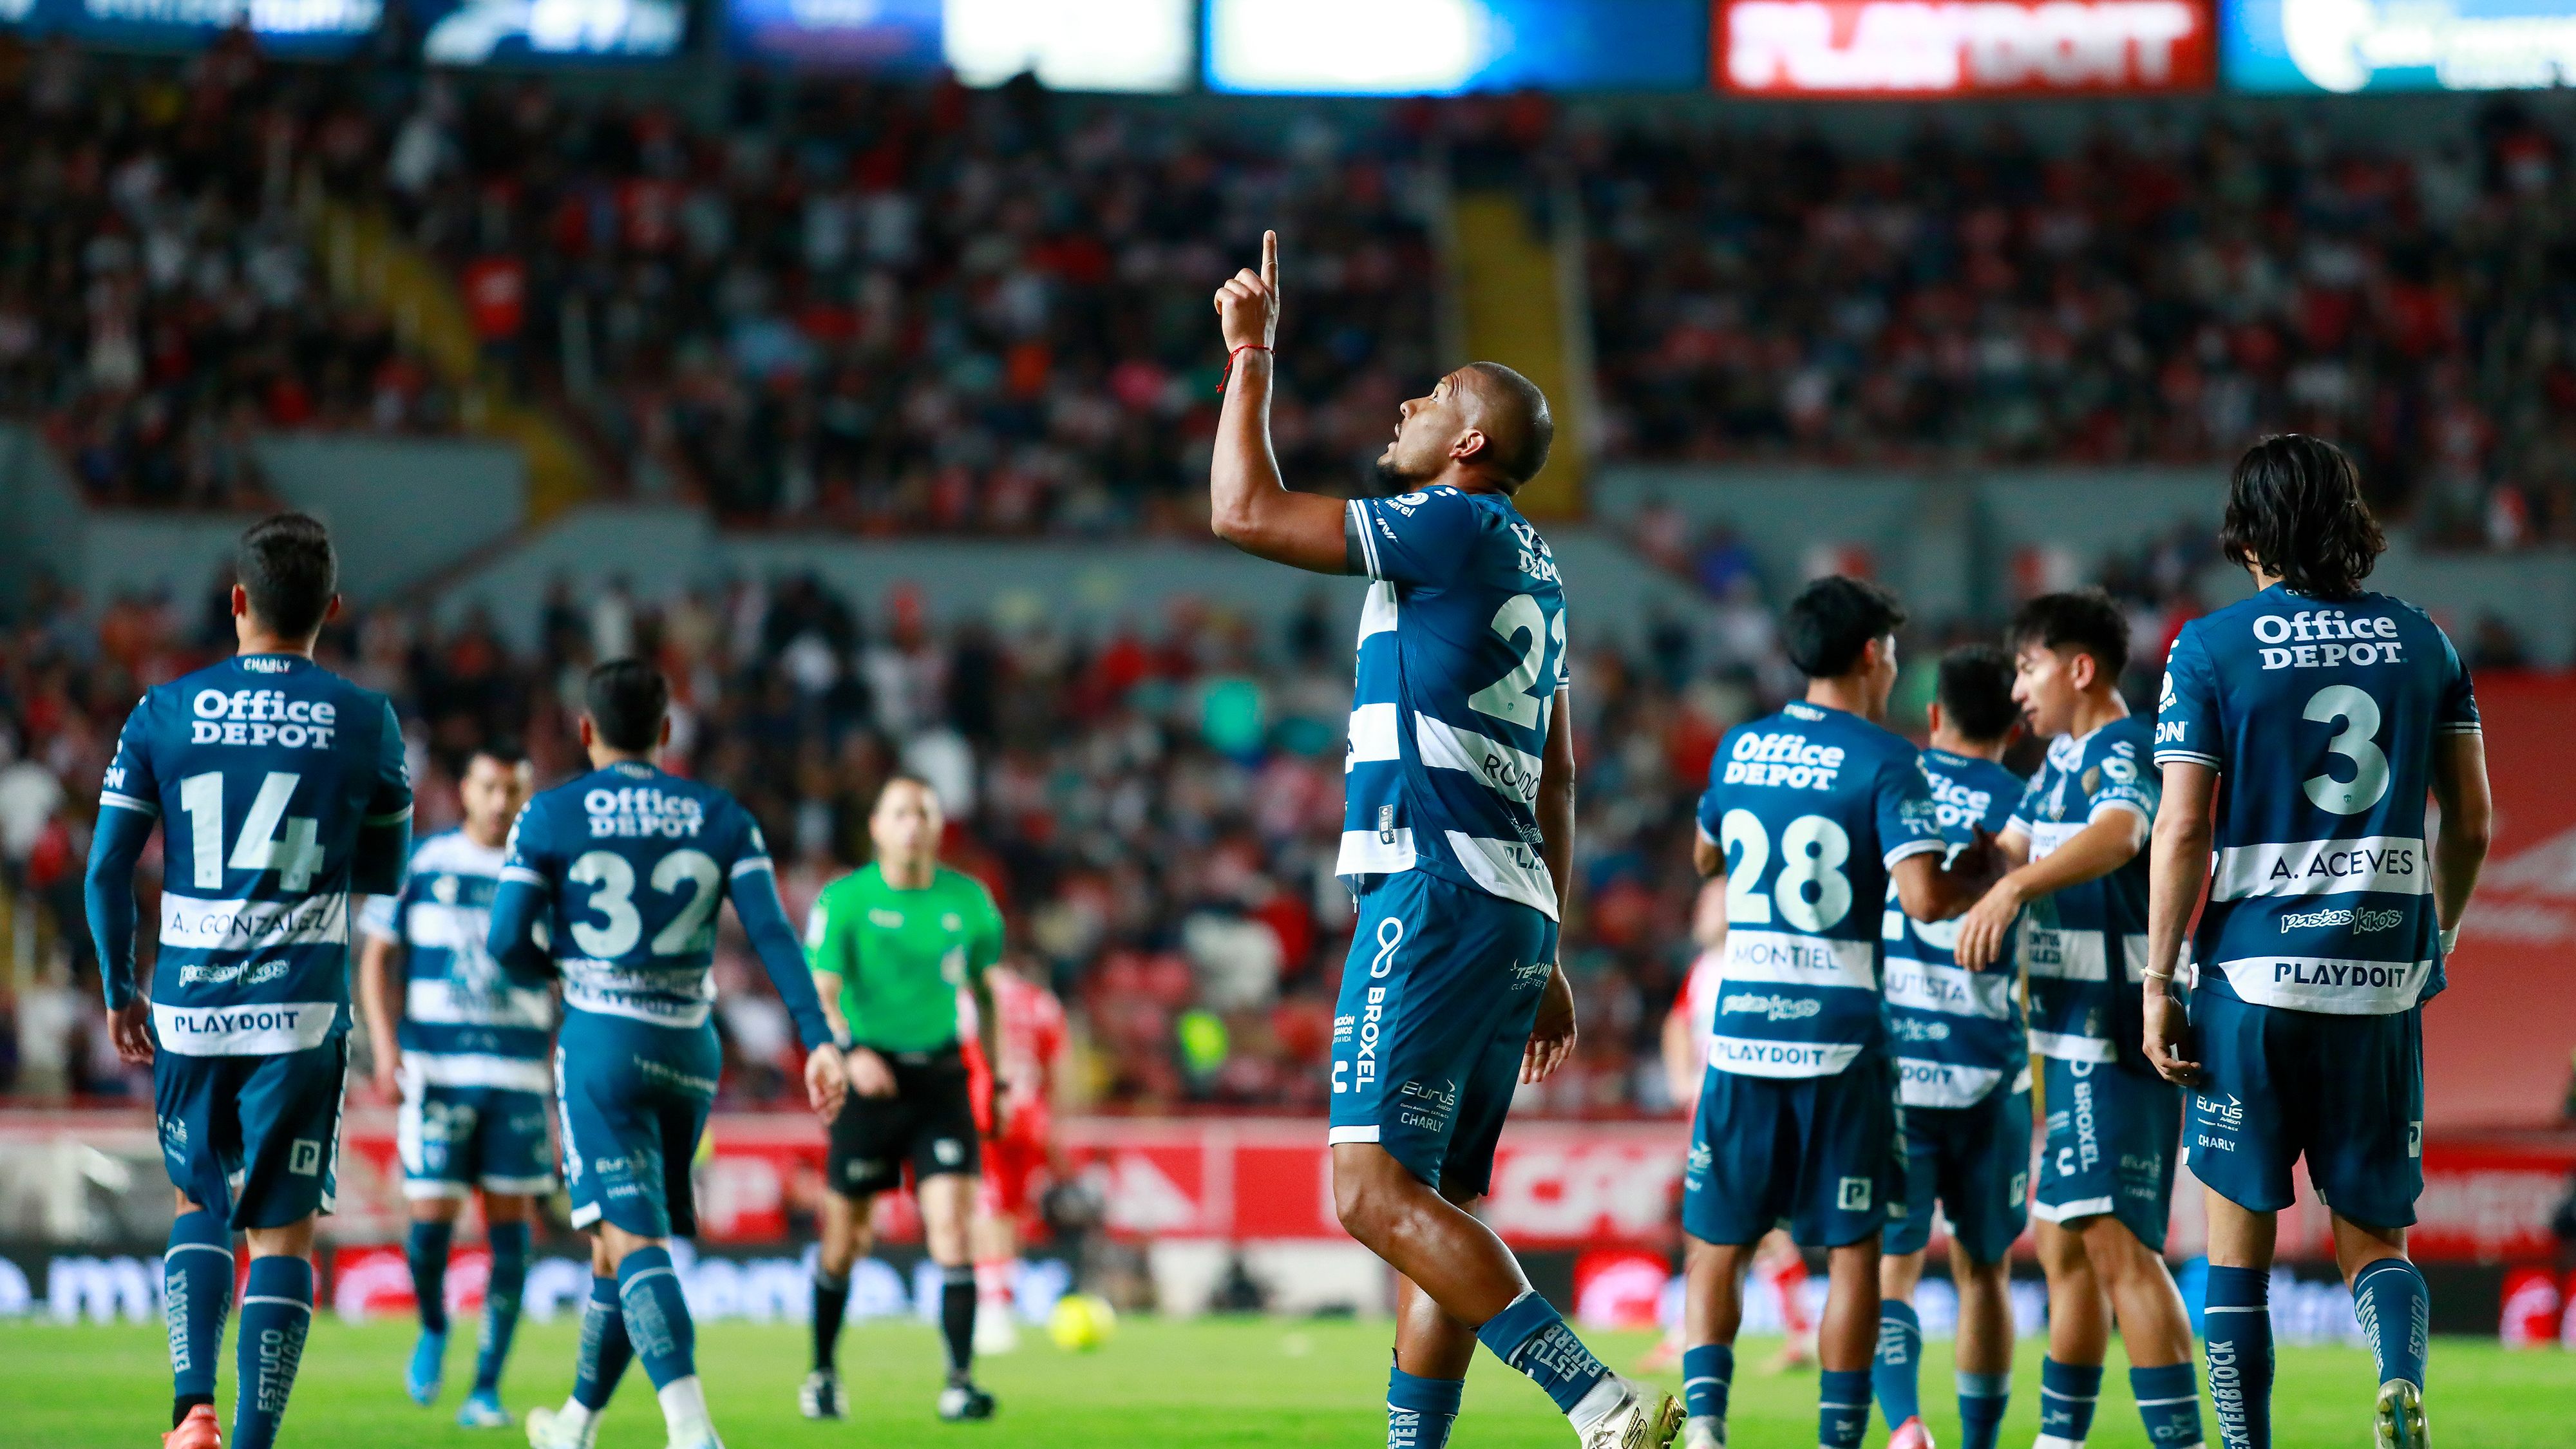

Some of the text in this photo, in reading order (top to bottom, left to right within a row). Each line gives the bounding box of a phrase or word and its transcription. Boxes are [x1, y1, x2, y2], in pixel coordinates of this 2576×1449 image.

[2253, 611, 2398, 644] Office
[2259, 642, 2403, 670] DEPOT
[193, 688, 336, 724] Office
[191, 720, 334, 749] DEPOT
[1732, 732, 1845, 768] Office
[2302, 685, 2390, 815] 3
[1723, 761, 1838, 791] DEPOT
[584, 786, 703, 817] Office
[180, 771, 325, 893] 14
[588, 815, 704, 838] DEPOT
[1721, 809, 1853, 933] 28
[2271, 849, 2413, 881] A. ACEVES
[569, 849, 721, 958] 32
[170, 912, 189, 934] A.
[1733, 943, 1838, 970] MONTIEL
[2275, 963, 2405, 988] PLAYDOIT
[175, 1011, 299, 1034] PLAYDOIT
[1356, 987, 1386, 1093] BROXEL
[1718, 1042, 1824, 1066] PLAYDOIT
[1401, 1081, 1455, 1106] Eurus
[2197, 1095, 2243, 1119] Eurus
[1401, 1112, 1444, 1132] CHARLY
[2074, 1081, 2099, 1173] BROXEL
[2199, 1134, 2235, 1151] CHARLY
[258, 1329, 284, 1411] ESTUCO
[2208, 1340, 2251, 1449] XTERBLOCK
